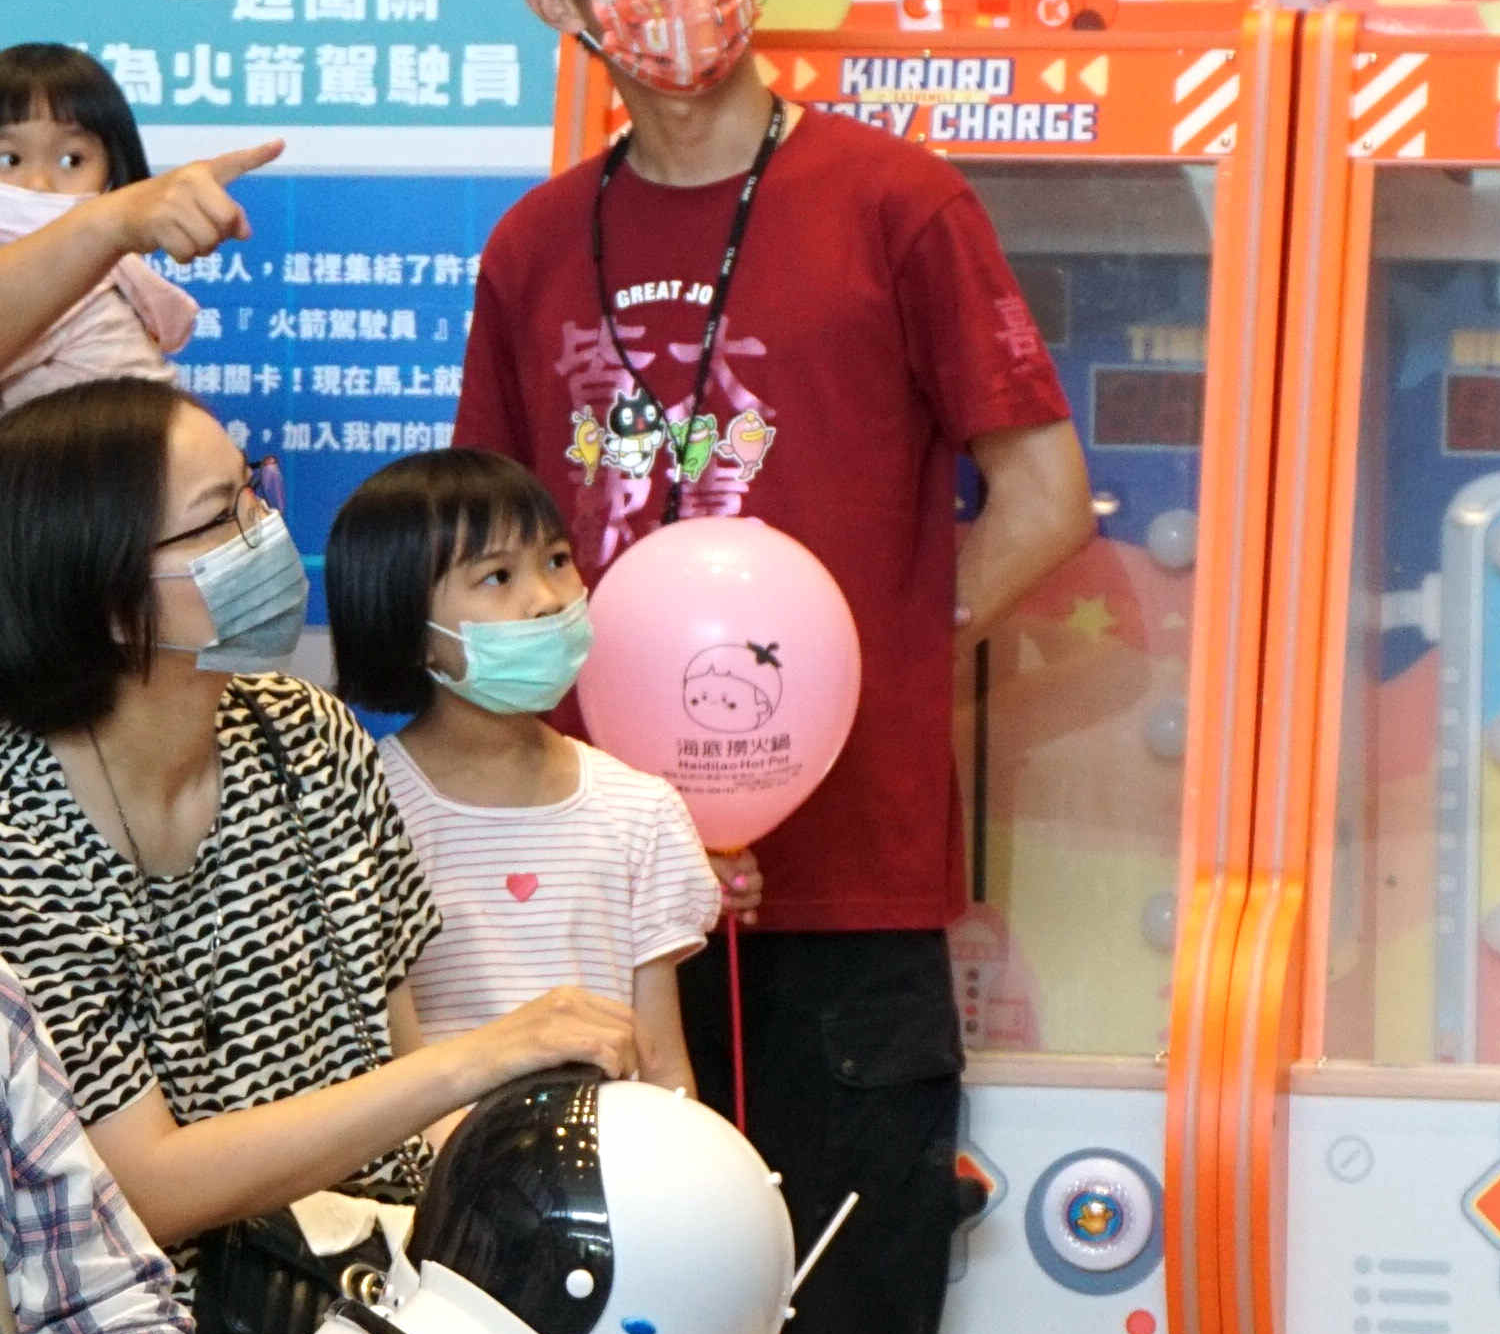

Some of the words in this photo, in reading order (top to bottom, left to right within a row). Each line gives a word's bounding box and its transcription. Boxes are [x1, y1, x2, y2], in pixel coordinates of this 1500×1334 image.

[75, 43, 522, 107] 為火箭駕駛員
[930, 103, 1097, 142] CHARGE
[614, 279, 683, 310] GREAT
[677, 759, 739, 772] Haidilao
[740, 758, 765, 770] Hot
[768, 754, 790, 768] Pot
